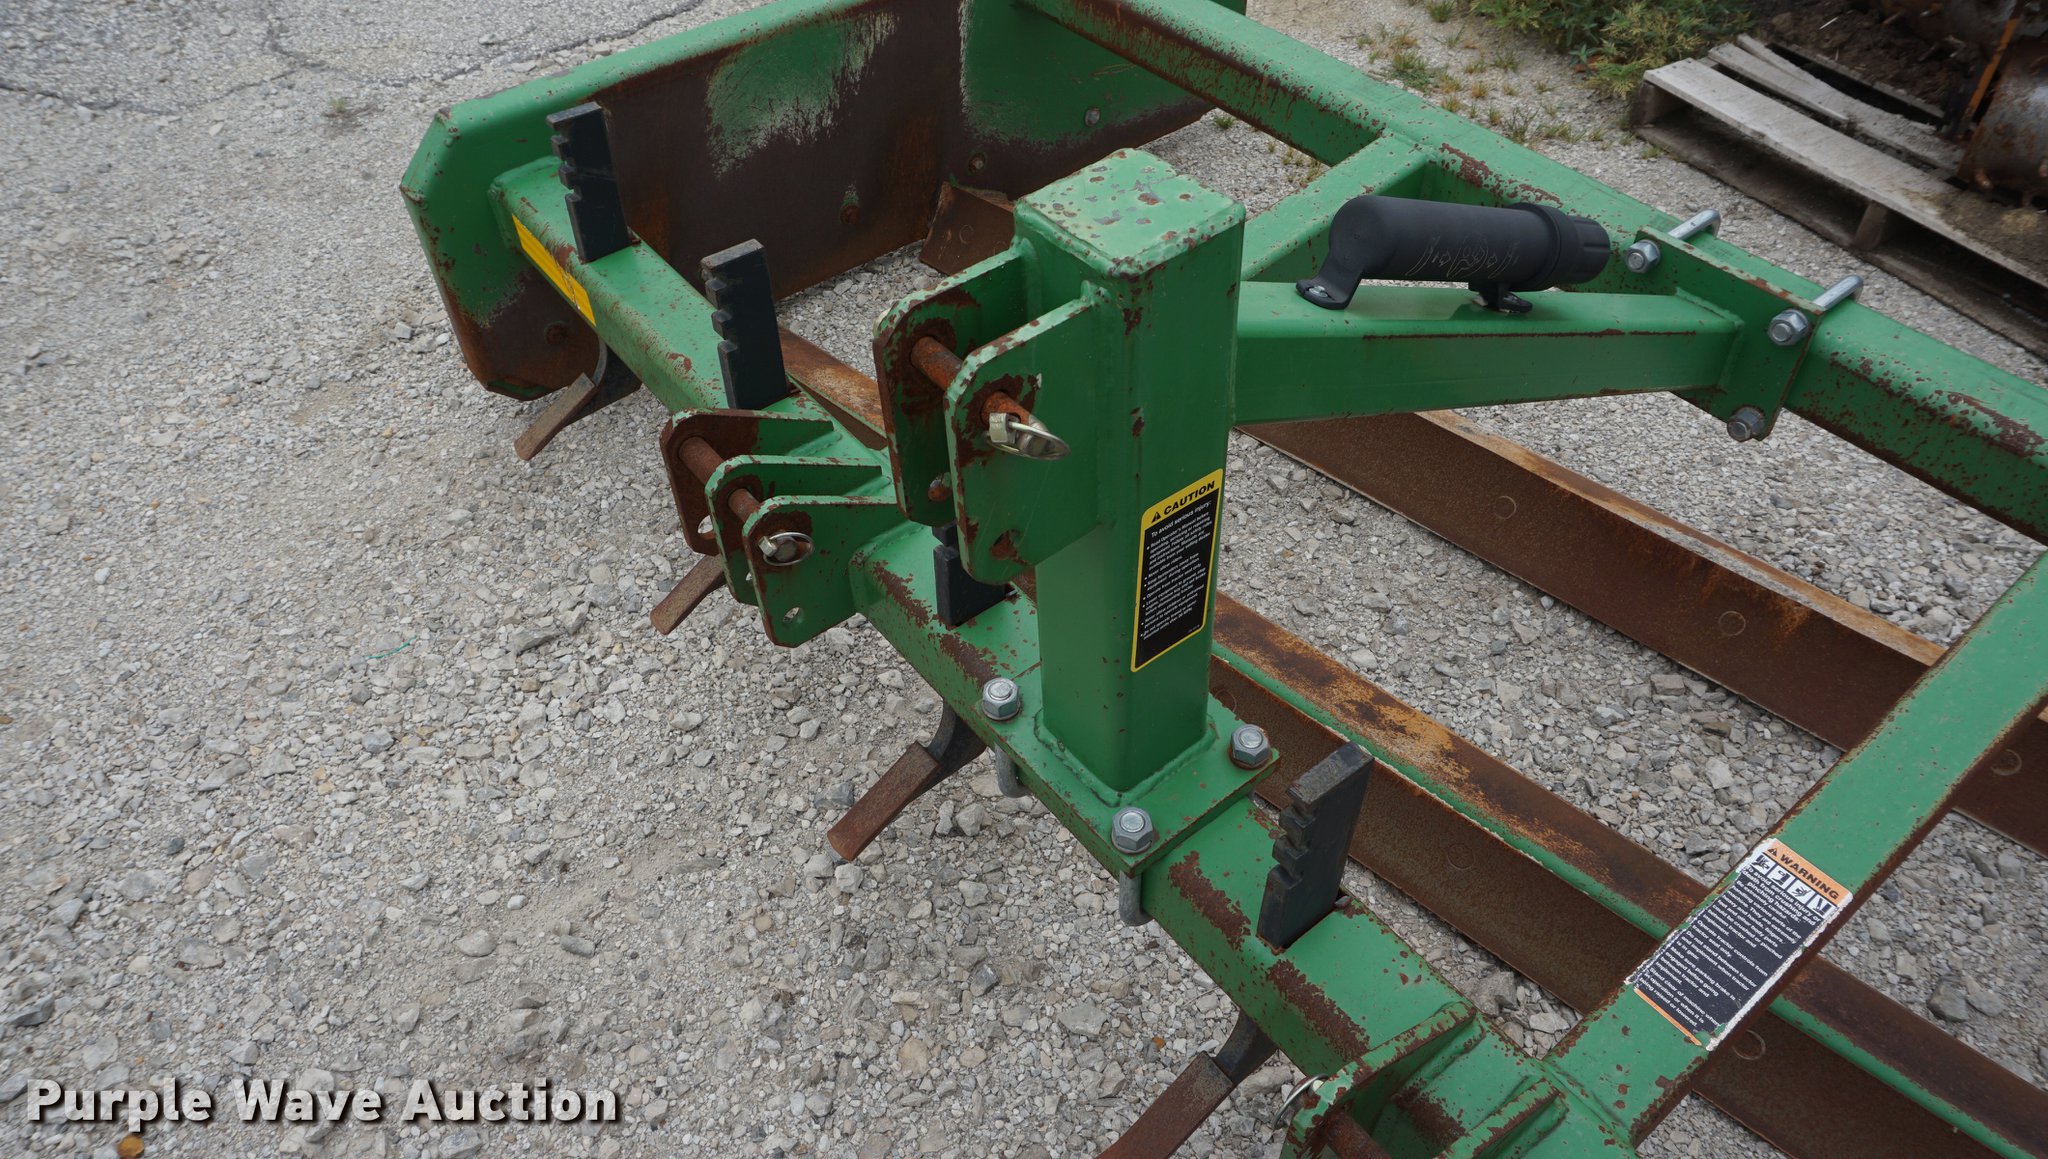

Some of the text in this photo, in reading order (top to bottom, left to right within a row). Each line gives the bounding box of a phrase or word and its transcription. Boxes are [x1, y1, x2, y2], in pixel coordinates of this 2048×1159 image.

[1163, 479, 1214, 516] CAUTION
[1778, 854, 1840, 899] WARNING
[1735, 880, 1744, 888] Be
[1743, 885, 1769, 906] extremely
[1741, 869, 1816, 926] death from crushing and
[1746, 881, 1774, 903] pinching
[1753, 871, 1771, 886] avoid
[1770, 883, 1794, 903] serious
[1793, 901, 1813, 917] injury
[1811, 915, 1821, 923] or
[1736, 905, 1748, 916] and
[1748, 907, 1762, 918] They
[1761, 916, 1771, 925] are
[1752, 901, 1772, 917] various
[1771, 915, 1786, 927] parts
[1791, 930, 1802, 939] the
[1691, 924, 1709, 940] tractor
[1726, 906, 1738, 916] and
[1750, 924, 1765, 937] body
[1763, 935, 1778, 947] parts
[1728, 925, 1746, 939] tractor
[1745, 938, 1756, 948] and
[1732, 920, 1755, 938] crushed
[1760, 941, 1783, 959] pinched
[1680, 935, 1692, 945] and
[1685, 930, 1694, 938] Do
[1693, 936, 1703, 945] not
[1701, 943, 1718, 957] stand
[1716, 955, 1739, 974] between
[1695, 919, 1717, 937] Operate
[1716, 935, 1734, 950] tractor
[1754, 965, 1768, 976] from
[1694, 966, 1716, 984] parking
[1697, 987, 1709, 997] and
[1702, 982, 1719, 996] going
